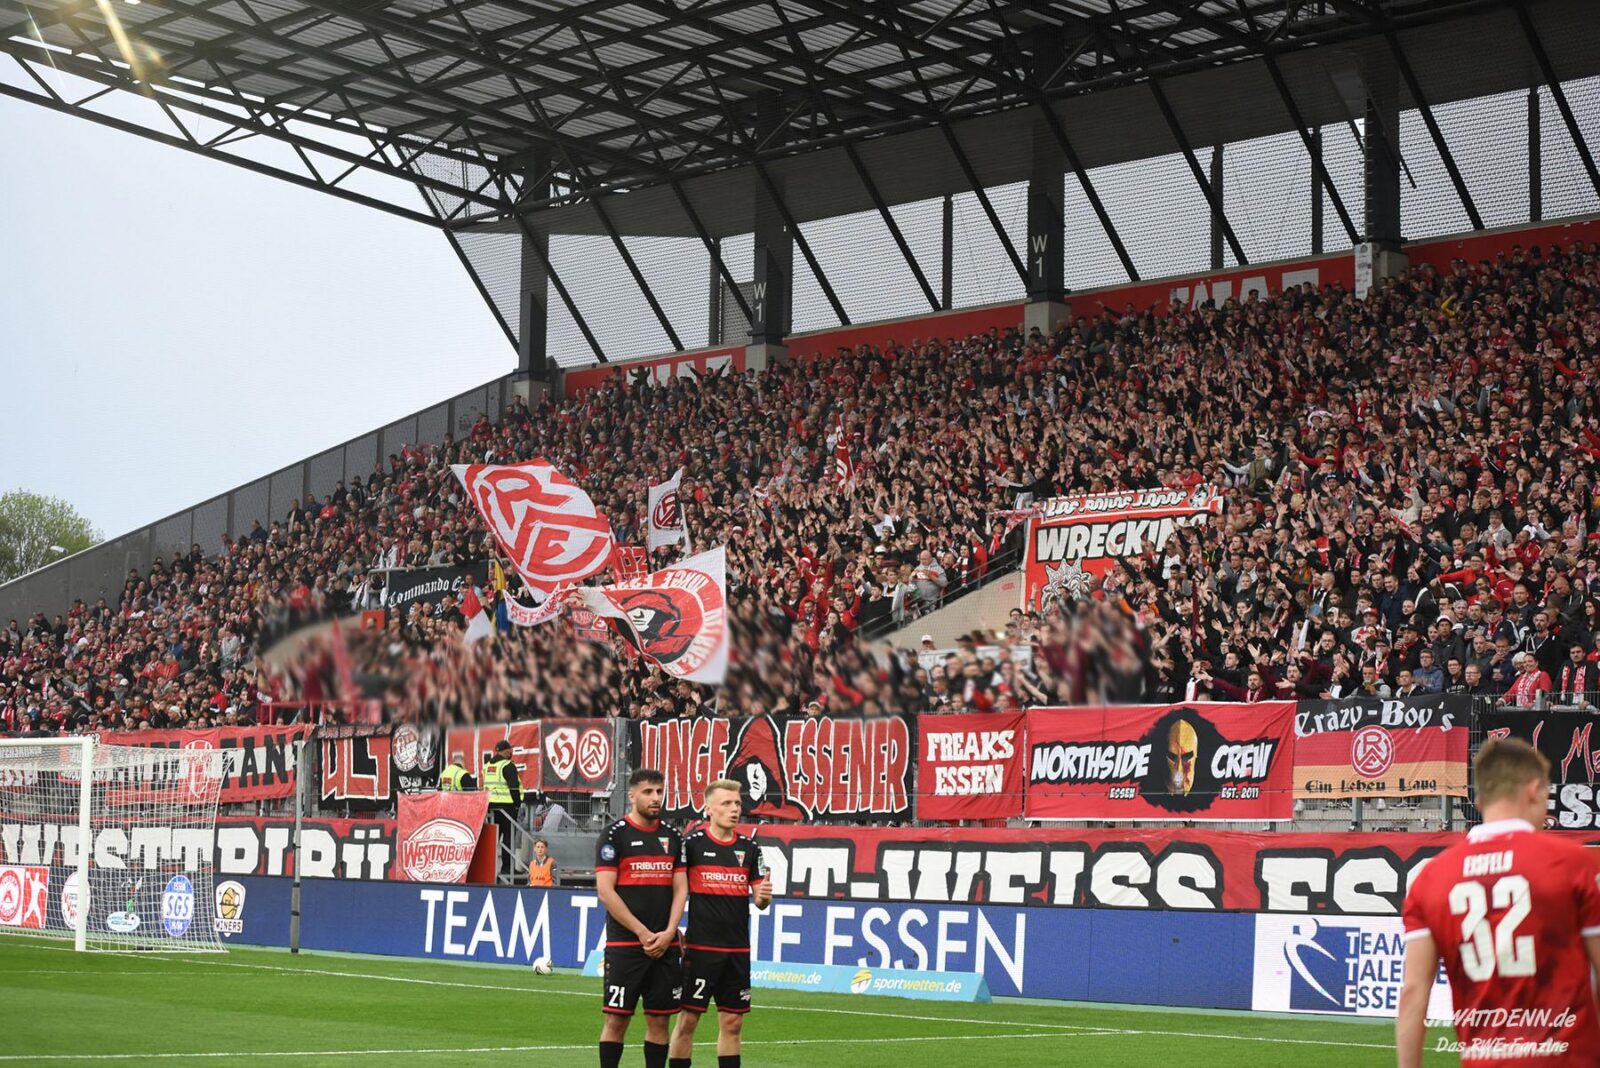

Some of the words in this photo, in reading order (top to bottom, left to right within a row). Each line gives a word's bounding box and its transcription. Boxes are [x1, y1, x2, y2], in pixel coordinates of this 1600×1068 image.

[1032, 234, 1048, 254] W
[1035, 256, 1043, 279] 1
[753, 281, 767, 300] W
[755, 302, 762, 323] 1
[926, 730, 1015, 762] FREAKS
[784, 716, 909, 814] ESSENER
[1030, 744, 1152, 781] NORTHSIDE
[1210, 743, 1274, 779] CREW
[935, 764, 1004, 796] ESSEN
[1108, 787, 1136, 800] ESSEN
[1220, 786, 1240, 800] EST.
[1240, 786, 1259, 799] 2011
[1448, 874, 1537, 982] 32
[420, 889, 551, 961] TEAM
[823, 904, 1027, 994] ESSEN
[692, 978, 707, 999] 2
[749, 973, 821, 986] ortwetten.de
[873, 977, 962, 994] sportwetten.de
[608, 984, 626, 1008] 21
